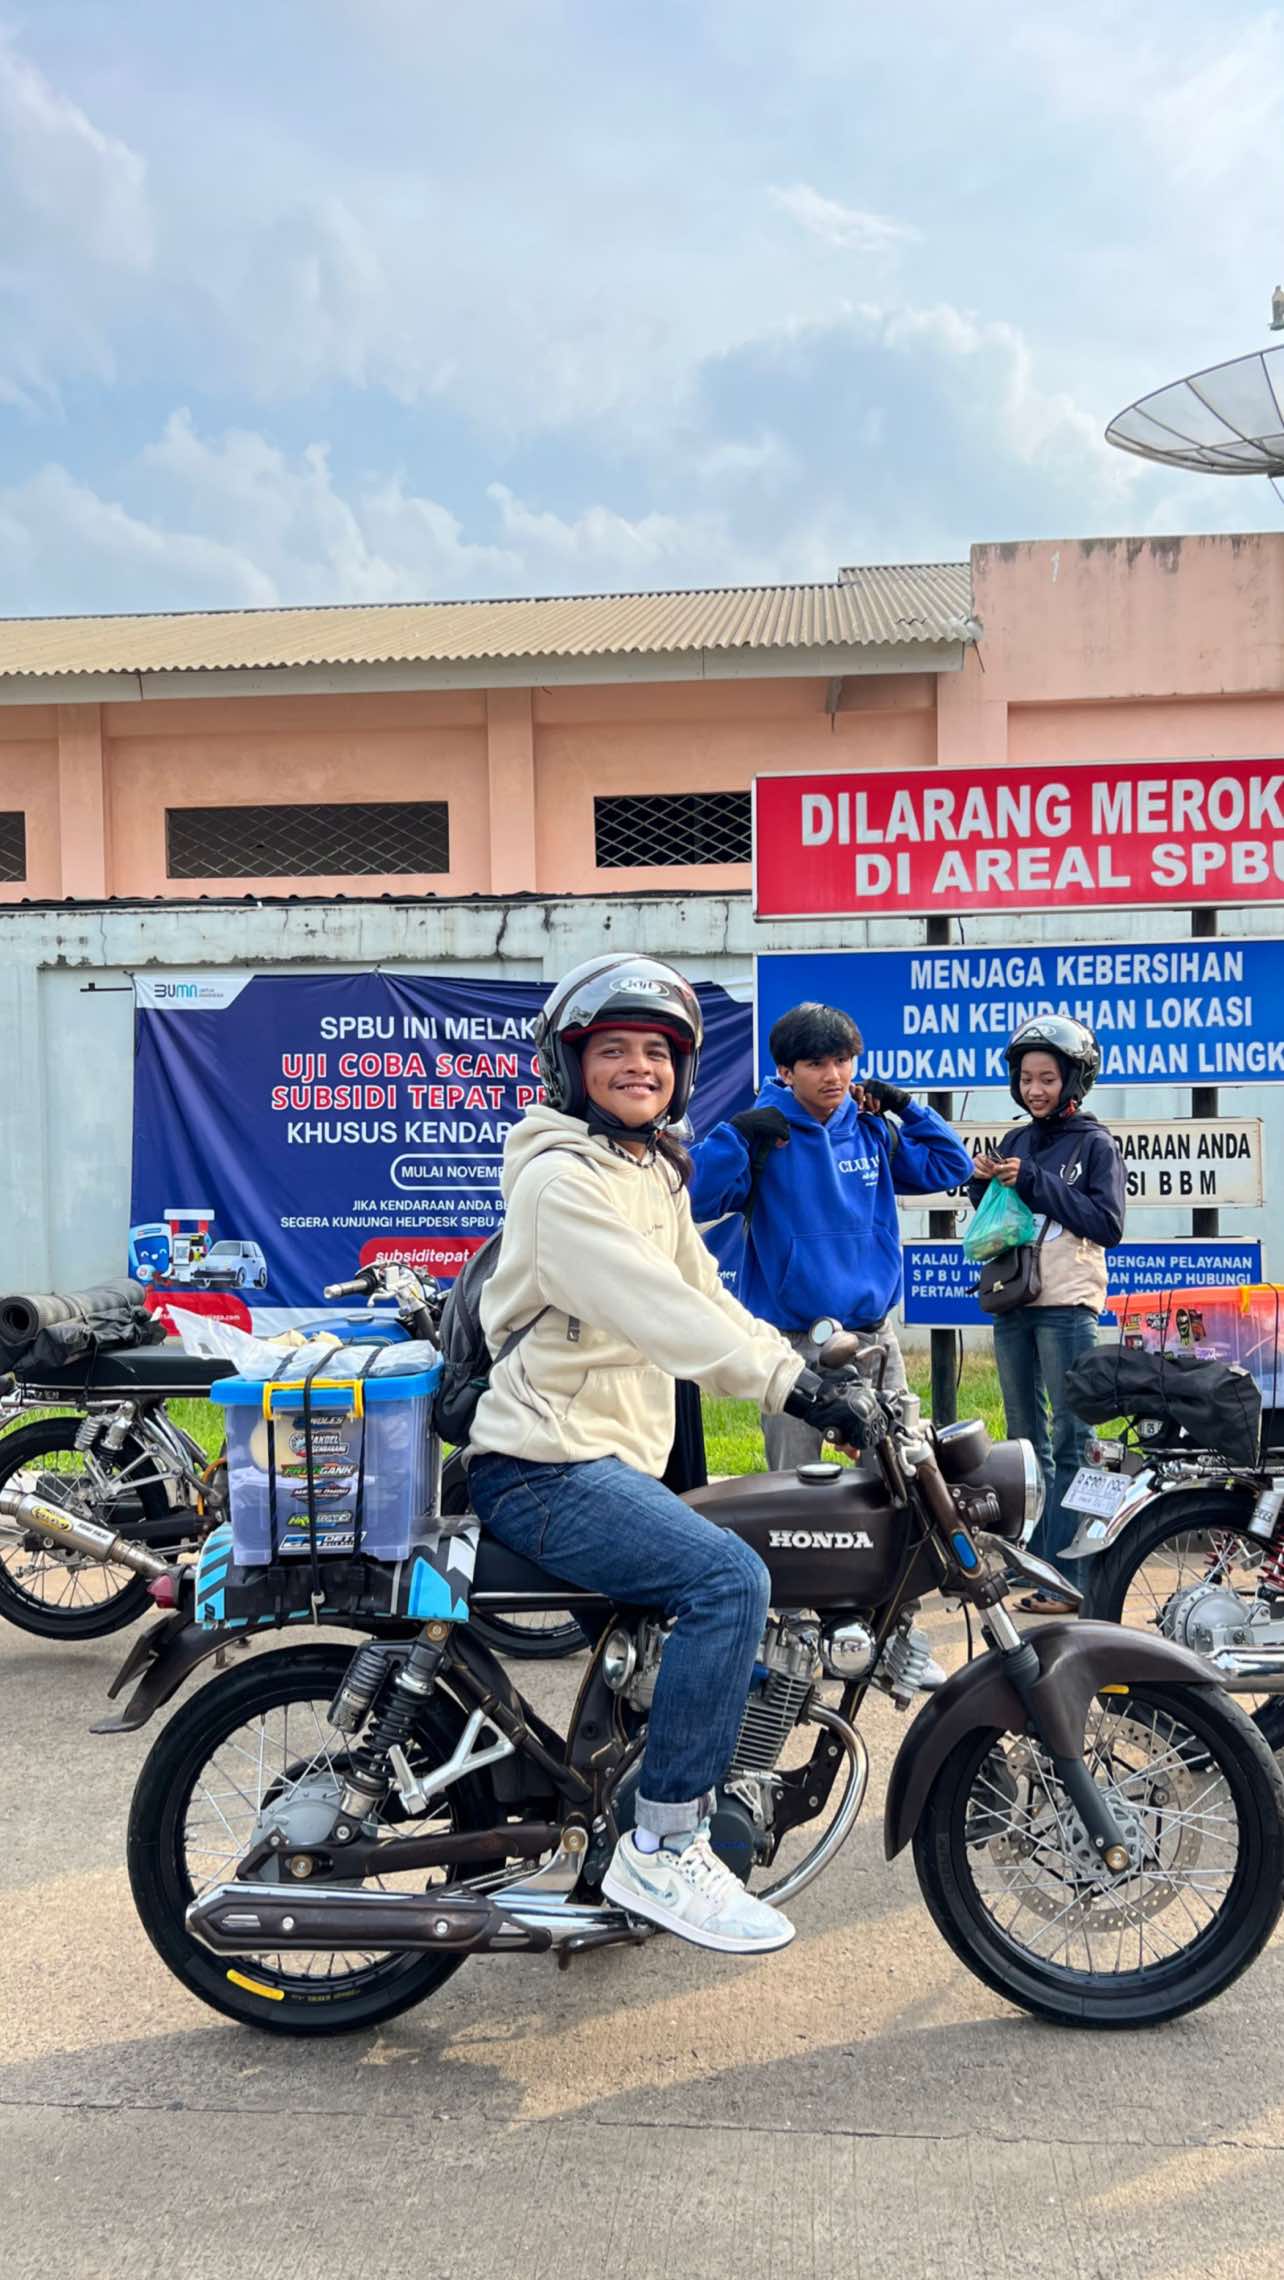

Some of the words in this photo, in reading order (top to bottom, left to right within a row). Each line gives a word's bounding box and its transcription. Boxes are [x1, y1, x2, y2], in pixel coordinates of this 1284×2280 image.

[801, 783, 1072, 846] DILARANG
[855, 853, 911, 897] DI
[932, 846, 1131, 894] AREAL
[911, 956, 1045, 990] MENJAGA
[1057, 951, 1244, 988] KEBERSIHAN
[320, 1016, 395, 1040] SPBU
[403, 1016, 437, 1040] INI
[903, 1003, 960, 1035] DAN
[1146, 997, 1252, 1029] LOKASI
[281, 1053, 327, 1083] UJI
[338, 1052, 427, 1078] COBA
[436, 1053, 518, 1078] SCAN
[271, 1085, 396, 1110] SUBSIDI
[408, 1085, 505, 1110] TEPAT
[288, 1121, 397, 1144] KHUSUS
[1197, 1133, 1251, 1159] ANDA
[401, 1166, 444, 1178] MULAI
[352, 1200, 377, 1211] JIKA
[380, 1200, 455, 1210] KENDARAAN
[457, 1200, 492, 1210] ANDA
[280, 1217, 329, 1228] SEGERA
[332, 1217, 393, 1227] KUNJUNGI
[396, 1217, 458, 1227] HELPDESK
[461, 1217, 494, 1227] SPBU
[911, 1253, 958, 1266] KALAU
[1108, 1256, 1165, 1268] DENGAN
[1170, 1256, 1253, 1269] PELAYANAN
[1134, 1272, 1182, 1284] HARAP
[1186, 1273, 1251, 1285] HUBUNGI
[768, 1530, 874, 1548] HONDA
